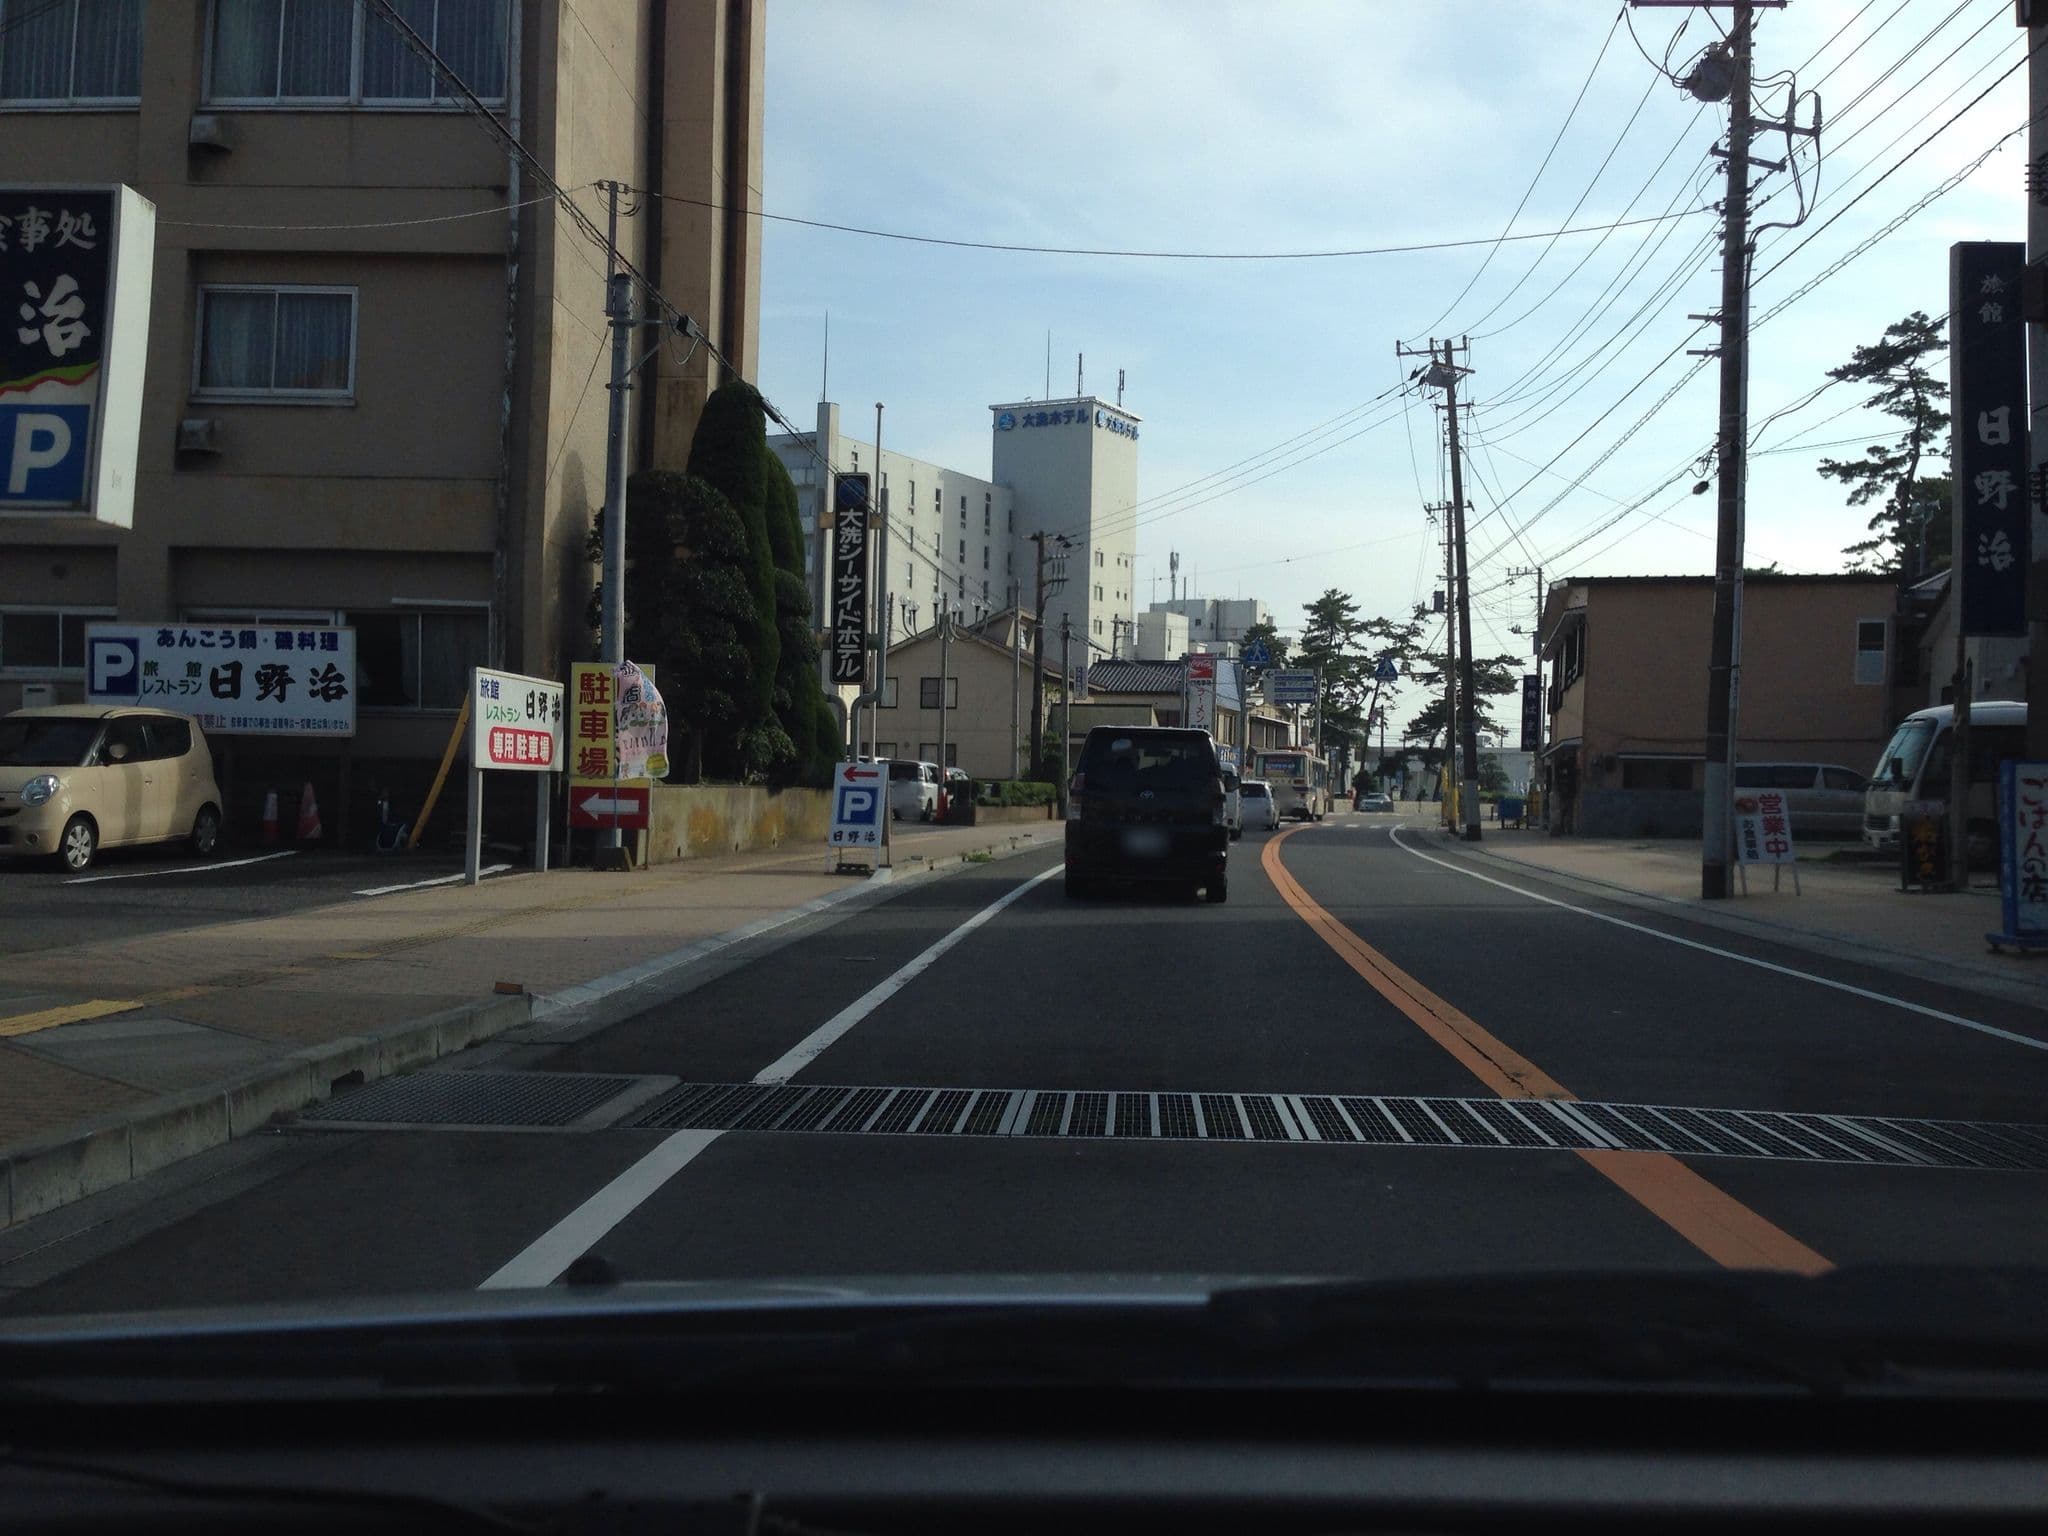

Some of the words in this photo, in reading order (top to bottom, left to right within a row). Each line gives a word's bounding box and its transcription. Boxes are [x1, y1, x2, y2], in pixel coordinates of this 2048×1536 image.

[17, 274, 92, 357] 治
[1978, 273, 2004, 323] 旅館
[8, 413, 72, 494] P
[1974, 405, 2018, 573] 日野治
[837, 508, 864, 678] 大洗シーサイドホテル
[157, 629, 339, 651] あんこう鍋・磯料理
[94, 642, 135, 690] P
[143, 660, 203, 678] 旅館
[209, 660, 349, 703] 日野治
[142, 679, 202, 695] レストラン
[480, 677, 500, 701] 旅館
[1196, 687, 1207, 723] ラーメン
[486, 703, 521, 723] レストラン
[526, 689, 561, 724] 日野治
[578, 672, 611, 779] 駐車場
[493, 731, 550, 762] 専用駐車場
[843, 791, 873, 820] P
[833, 831, 877, 843] 日野治
[1759, 793, 1789, 859] 営業中
